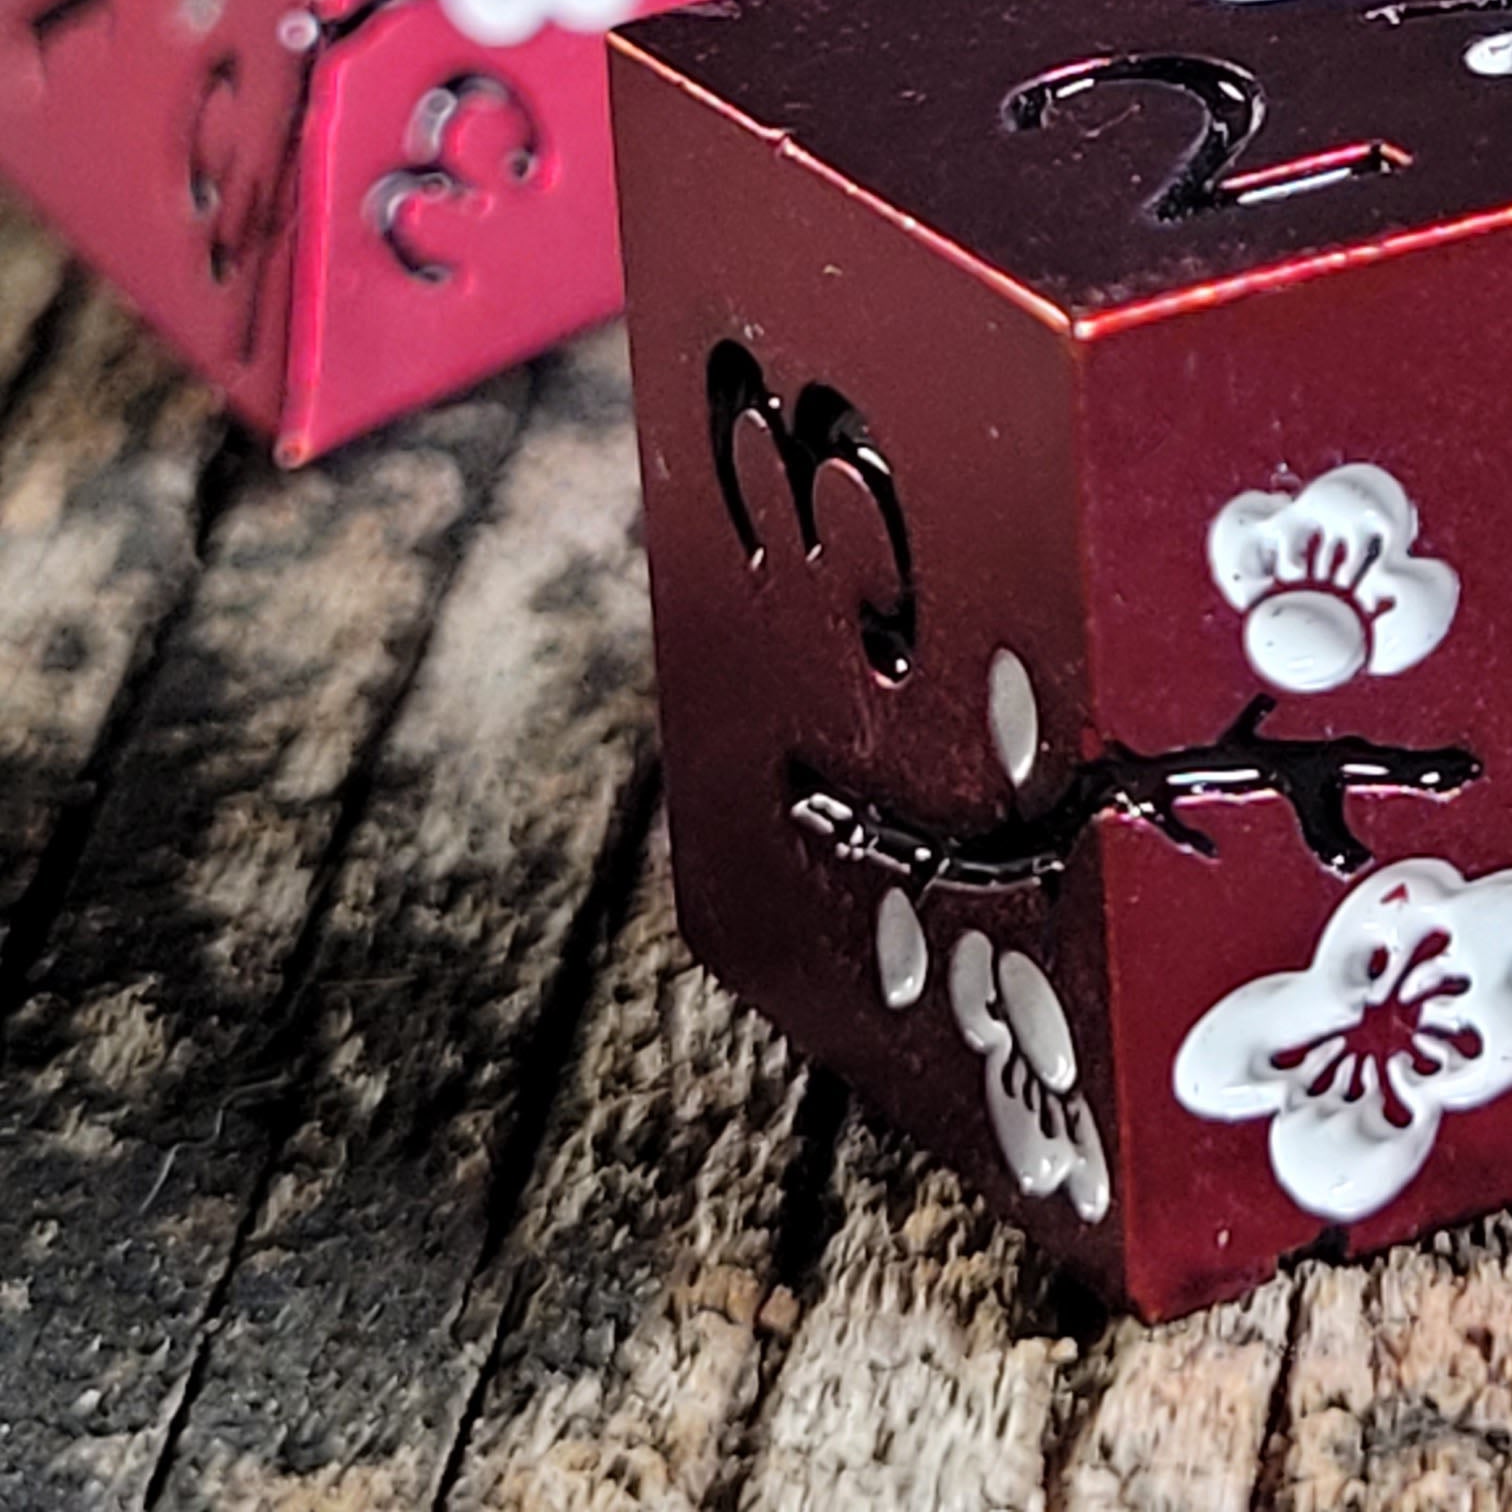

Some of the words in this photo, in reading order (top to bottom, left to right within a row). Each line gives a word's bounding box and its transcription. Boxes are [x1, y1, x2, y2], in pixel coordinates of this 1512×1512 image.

[362, 69, 558, 290] 3
[1001, 52, 1412, 223] 2
[705, 338, 918, 689] 3
